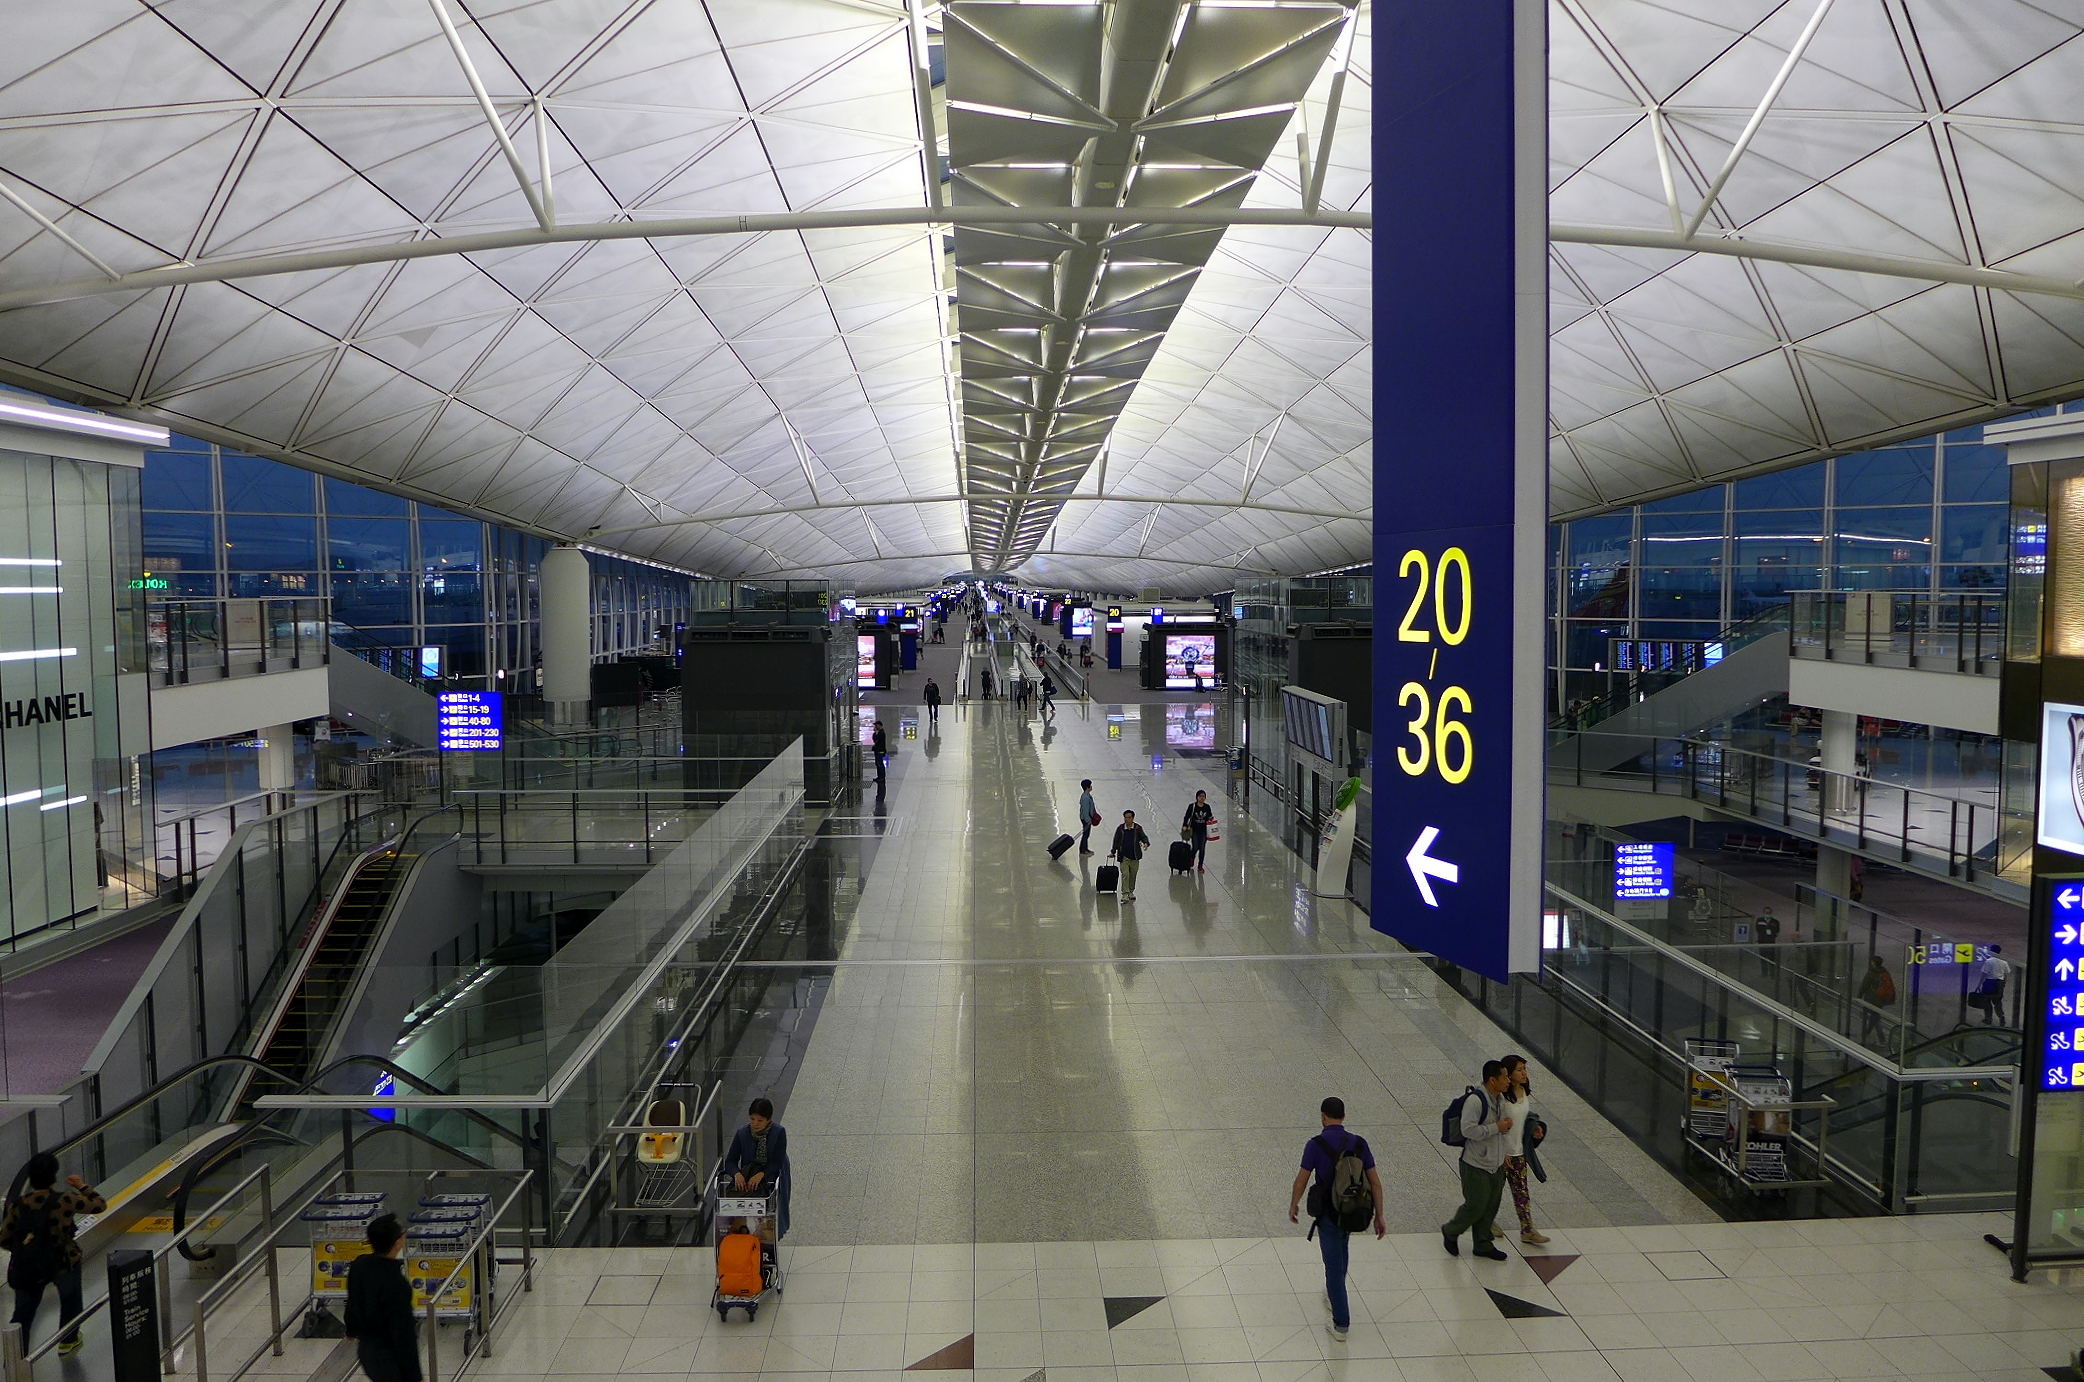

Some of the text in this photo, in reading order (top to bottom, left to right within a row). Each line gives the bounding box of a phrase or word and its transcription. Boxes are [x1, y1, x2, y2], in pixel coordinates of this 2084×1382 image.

[1398, 546, 1472, 646] 20
[904, 609, 915, 618] 21
[1109, 608, 1120, 617] 20
[468, 693, 481, 703] 1-4
[0, 692, 93, 729] HANEL
[1397, 681, 1473, 784] 36
